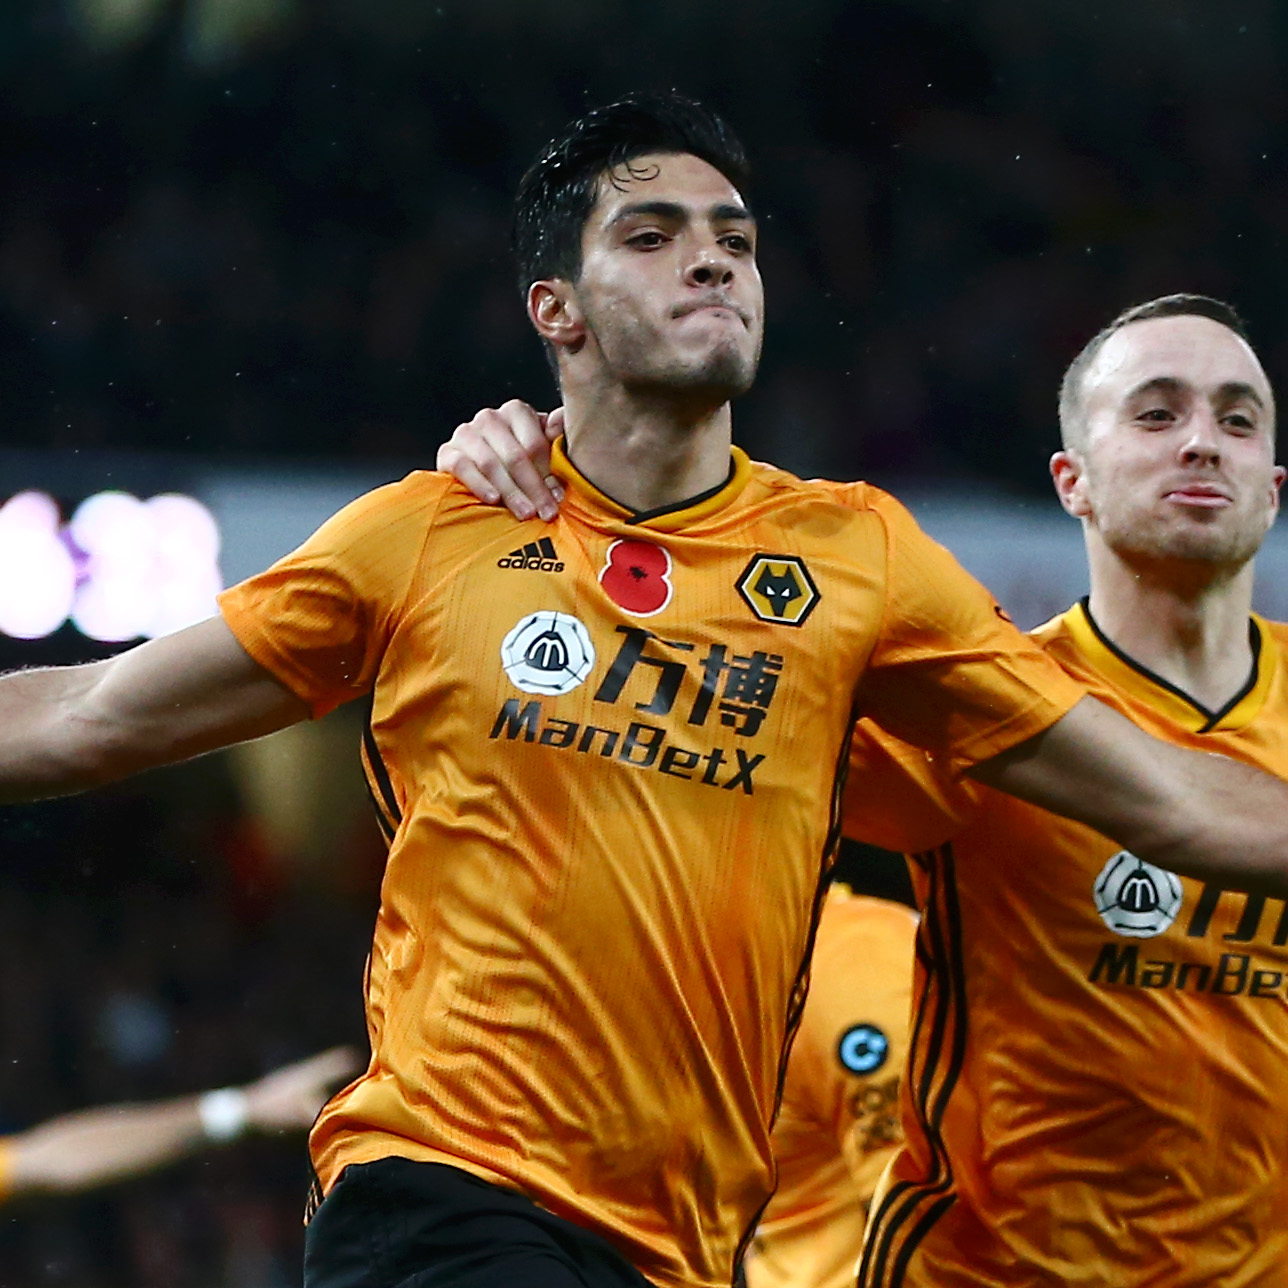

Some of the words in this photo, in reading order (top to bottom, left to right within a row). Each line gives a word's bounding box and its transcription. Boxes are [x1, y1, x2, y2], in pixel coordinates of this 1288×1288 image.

[497, 554, 565, 573] adidas
[594, 625, 783, 737] 万博
[489, 698, 766, 795] ManBetX
